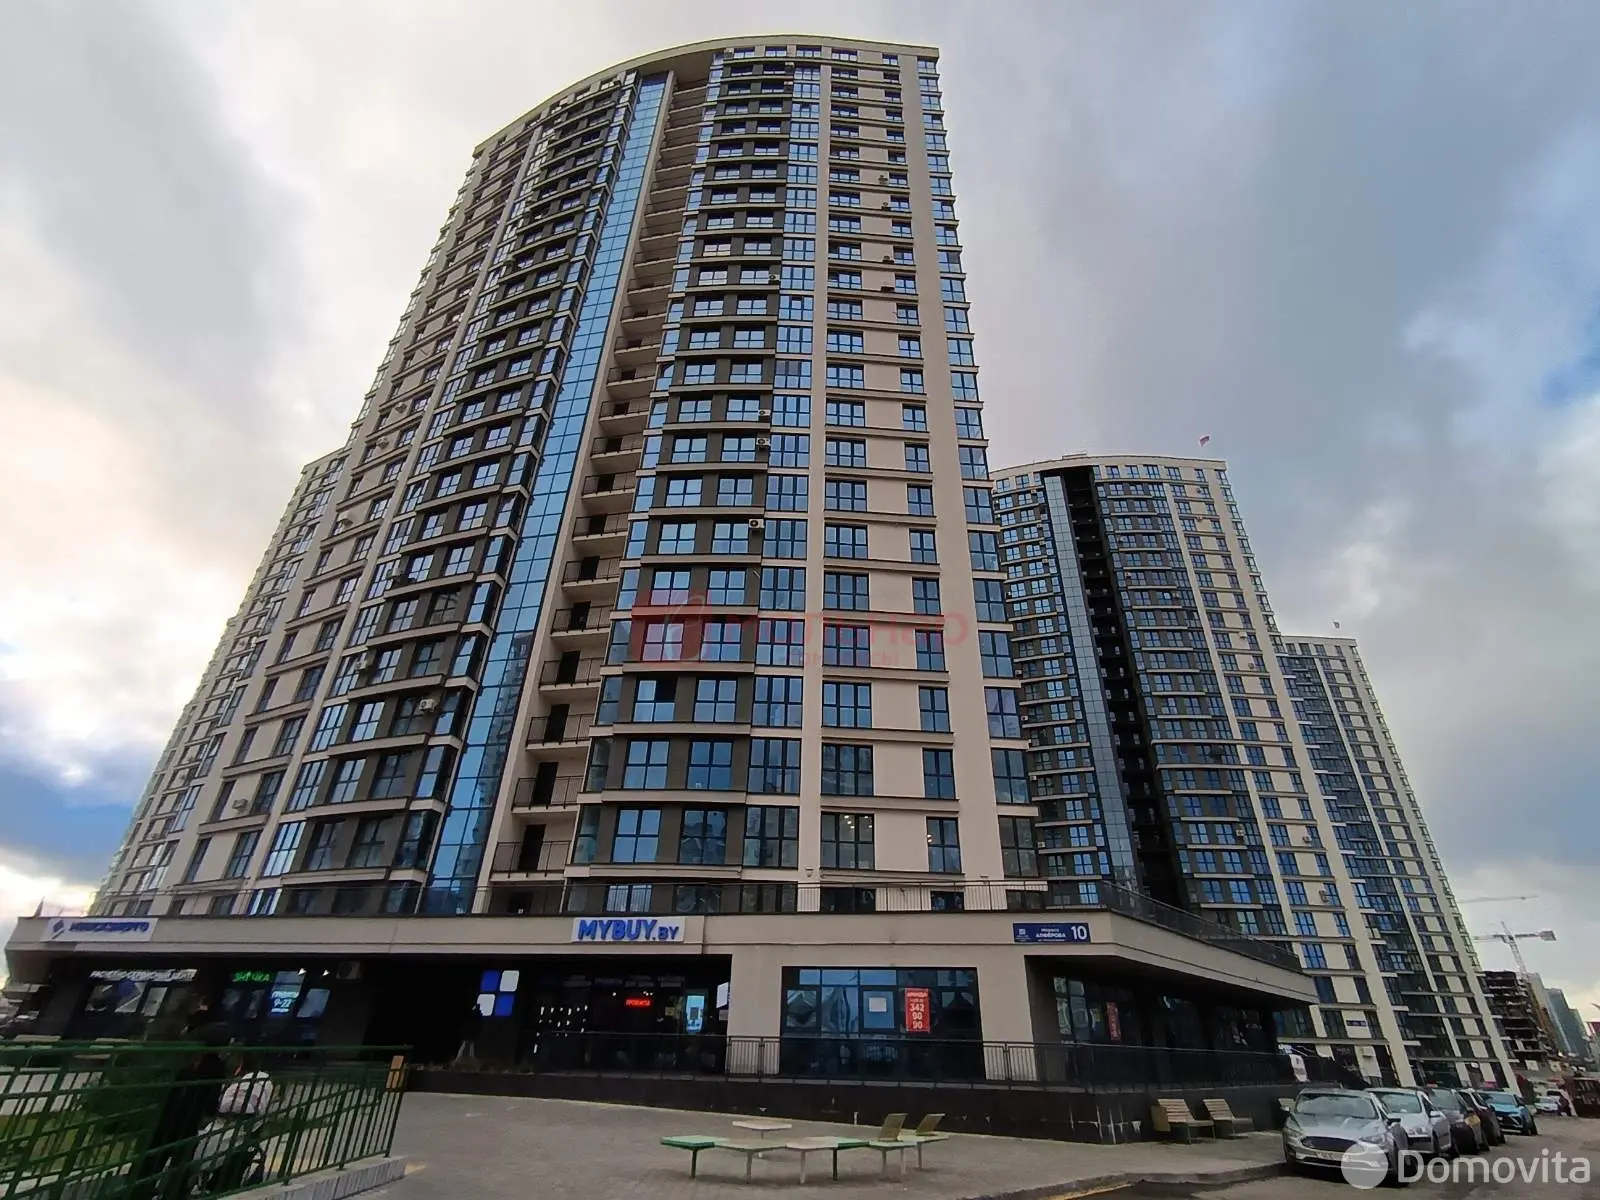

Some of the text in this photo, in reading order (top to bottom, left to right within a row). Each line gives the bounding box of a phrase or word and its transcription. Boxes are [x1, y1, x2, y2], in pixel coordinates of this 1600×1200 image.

[577, 919, 679, 940] MYBUY.BY
[1071, 925, 1088, 940] 10
[910, 1003, 925, 1012] 342
